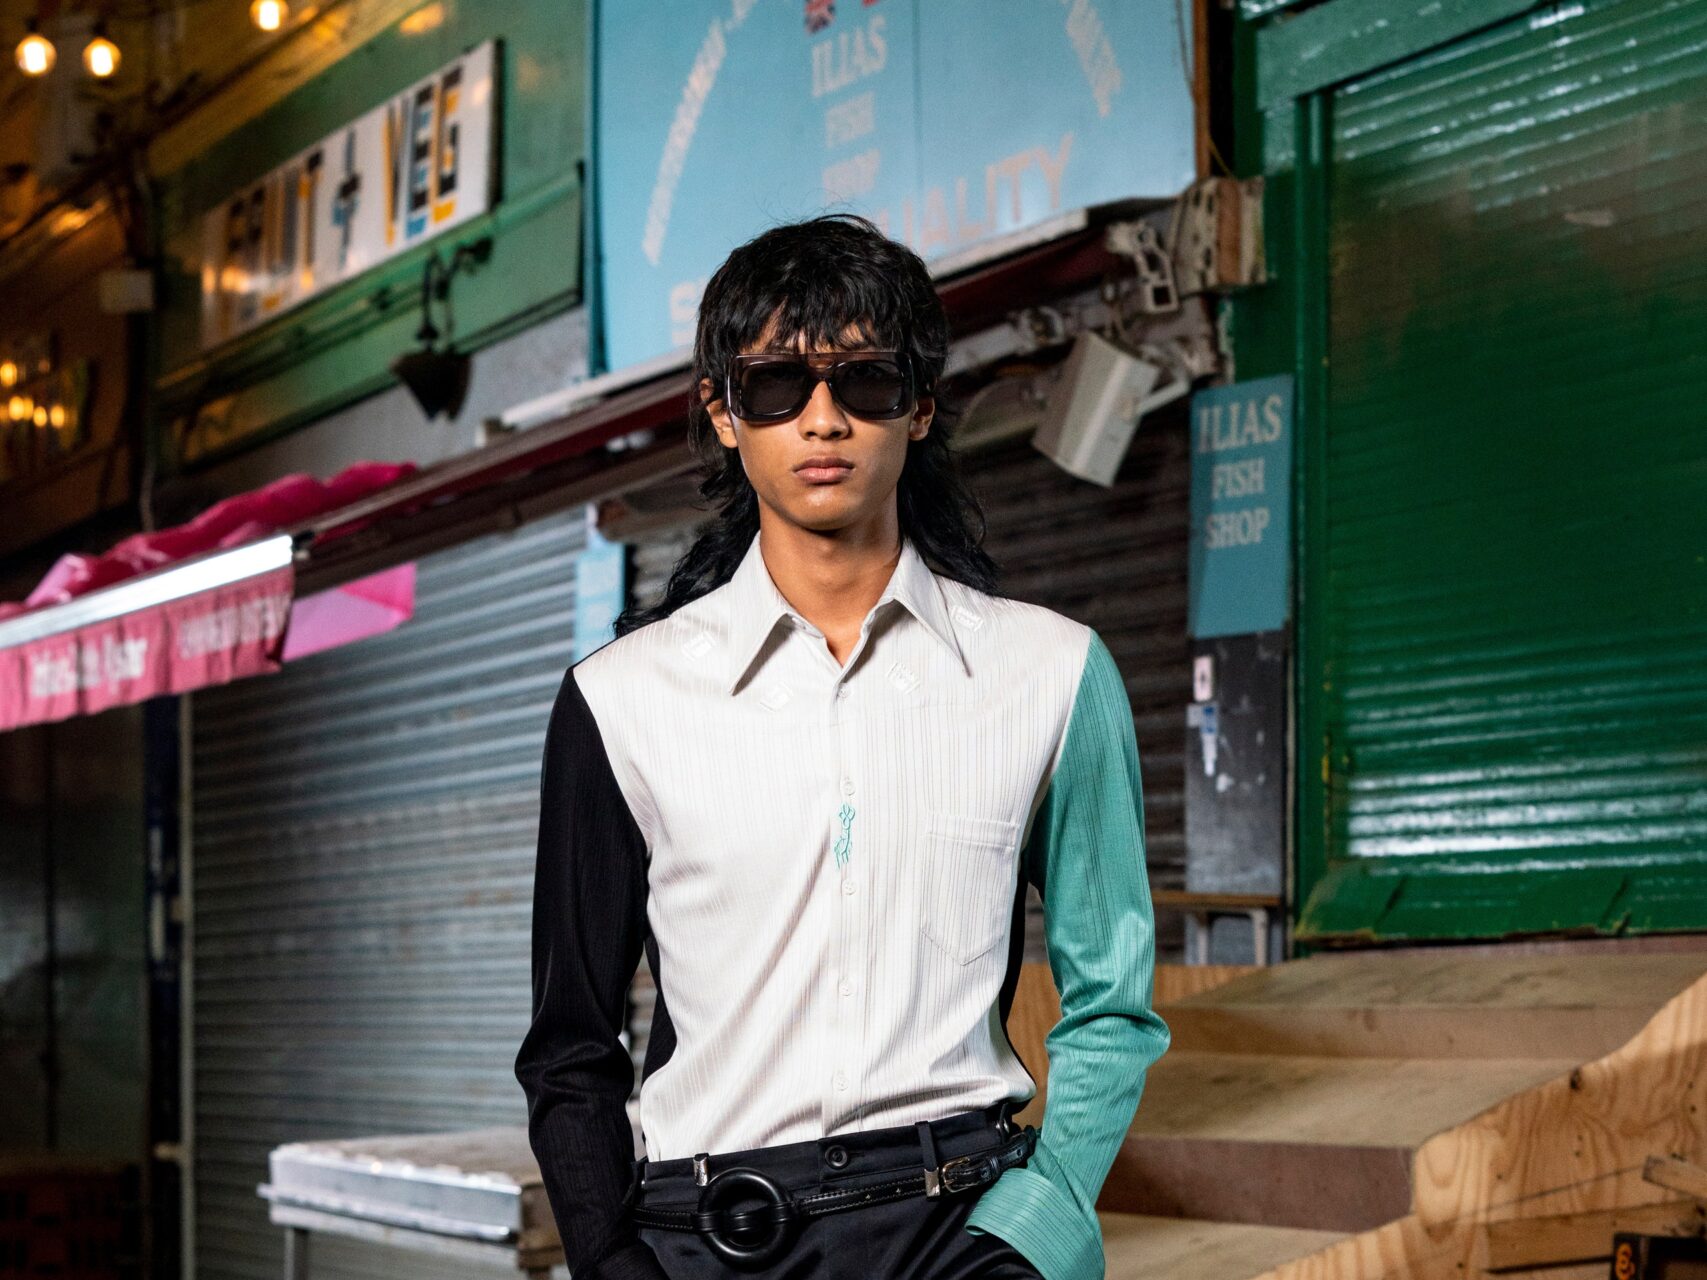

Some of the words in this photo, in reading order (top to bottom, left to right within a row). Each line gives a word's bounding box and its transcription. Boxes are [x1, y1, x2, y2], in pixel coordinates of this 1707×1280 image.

[812, 13, 888, 98] ILIAS
[382, 63, 464, 246] VEG
[878, 131, 1074, 258] UALITY
[1198, 395, 1282, 453] ILIAS
[1212, 458, 1266, 499] FISH
[1205, 507, 1270, 549] SHOP
